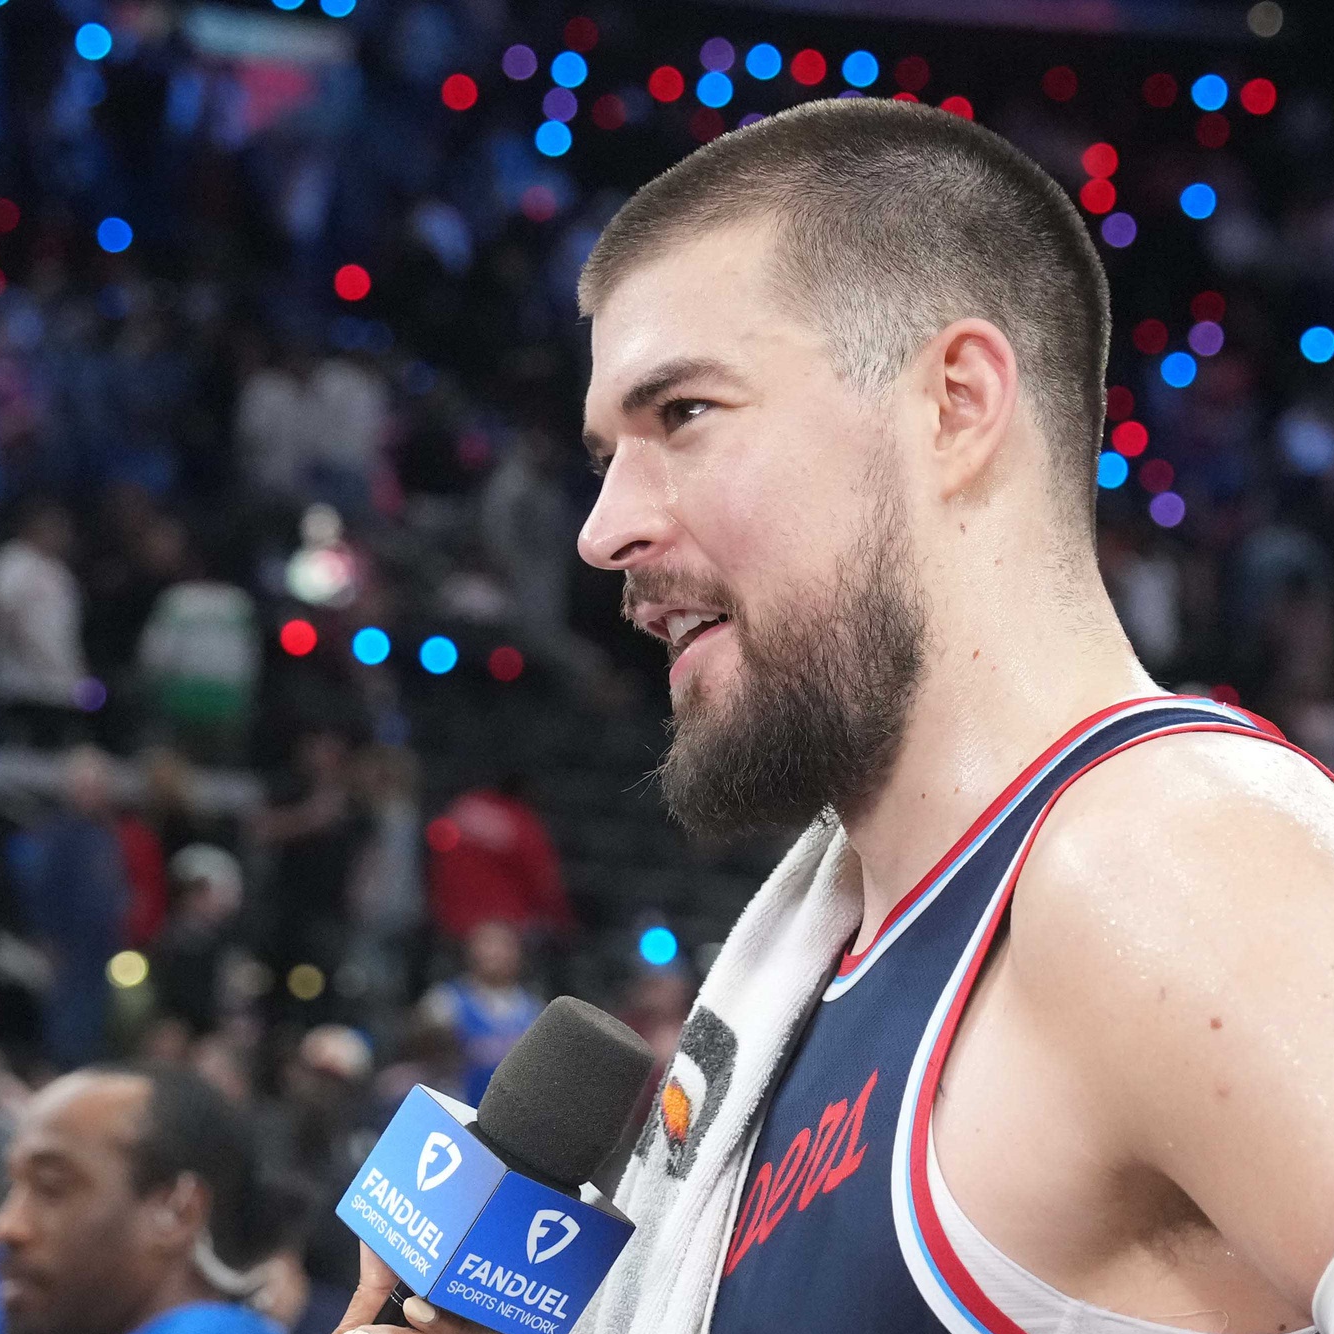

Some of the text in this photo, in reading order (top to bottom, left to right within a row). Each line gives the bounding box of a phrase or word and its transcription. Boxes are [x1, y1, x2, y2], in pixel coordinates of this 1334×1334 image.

[351, 1194, 432, 1277] SPORTS NETWORK
[361, 1167, 444, 1260] FANDUEL
[447, 1280, 498, 1310] SPORTS
[457, 1253, 569, 1319] FANDUEL
